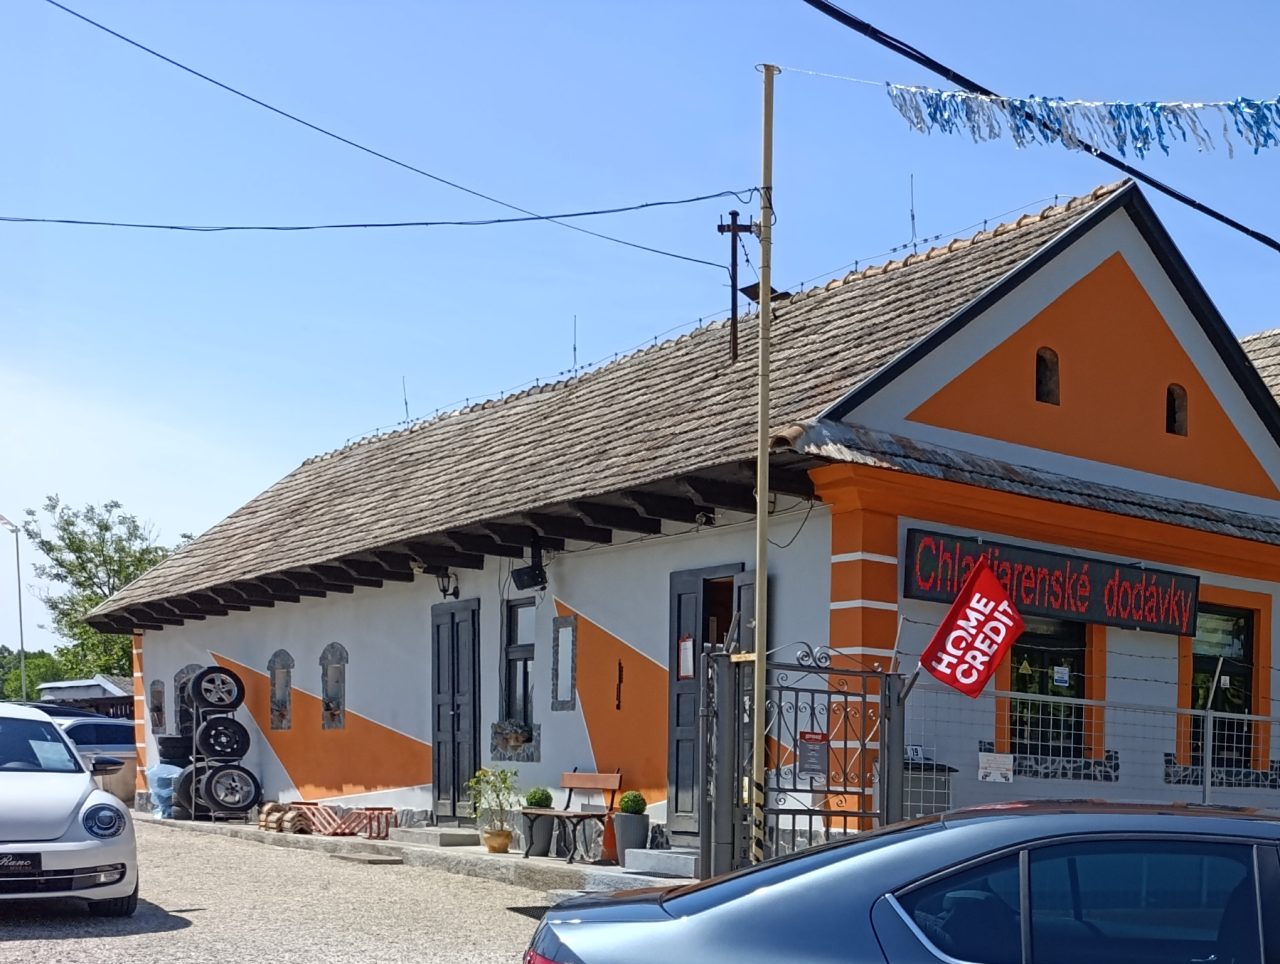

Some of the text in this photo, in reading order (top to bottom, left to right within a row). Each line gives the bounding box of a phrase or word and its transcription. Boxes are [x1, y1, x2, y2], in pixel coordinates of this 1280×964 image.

[931, 592, 995, 675] HOME
[955, 600, 1018, 684] CREDIT
[1104, 568, 1192, 633] dodávky
